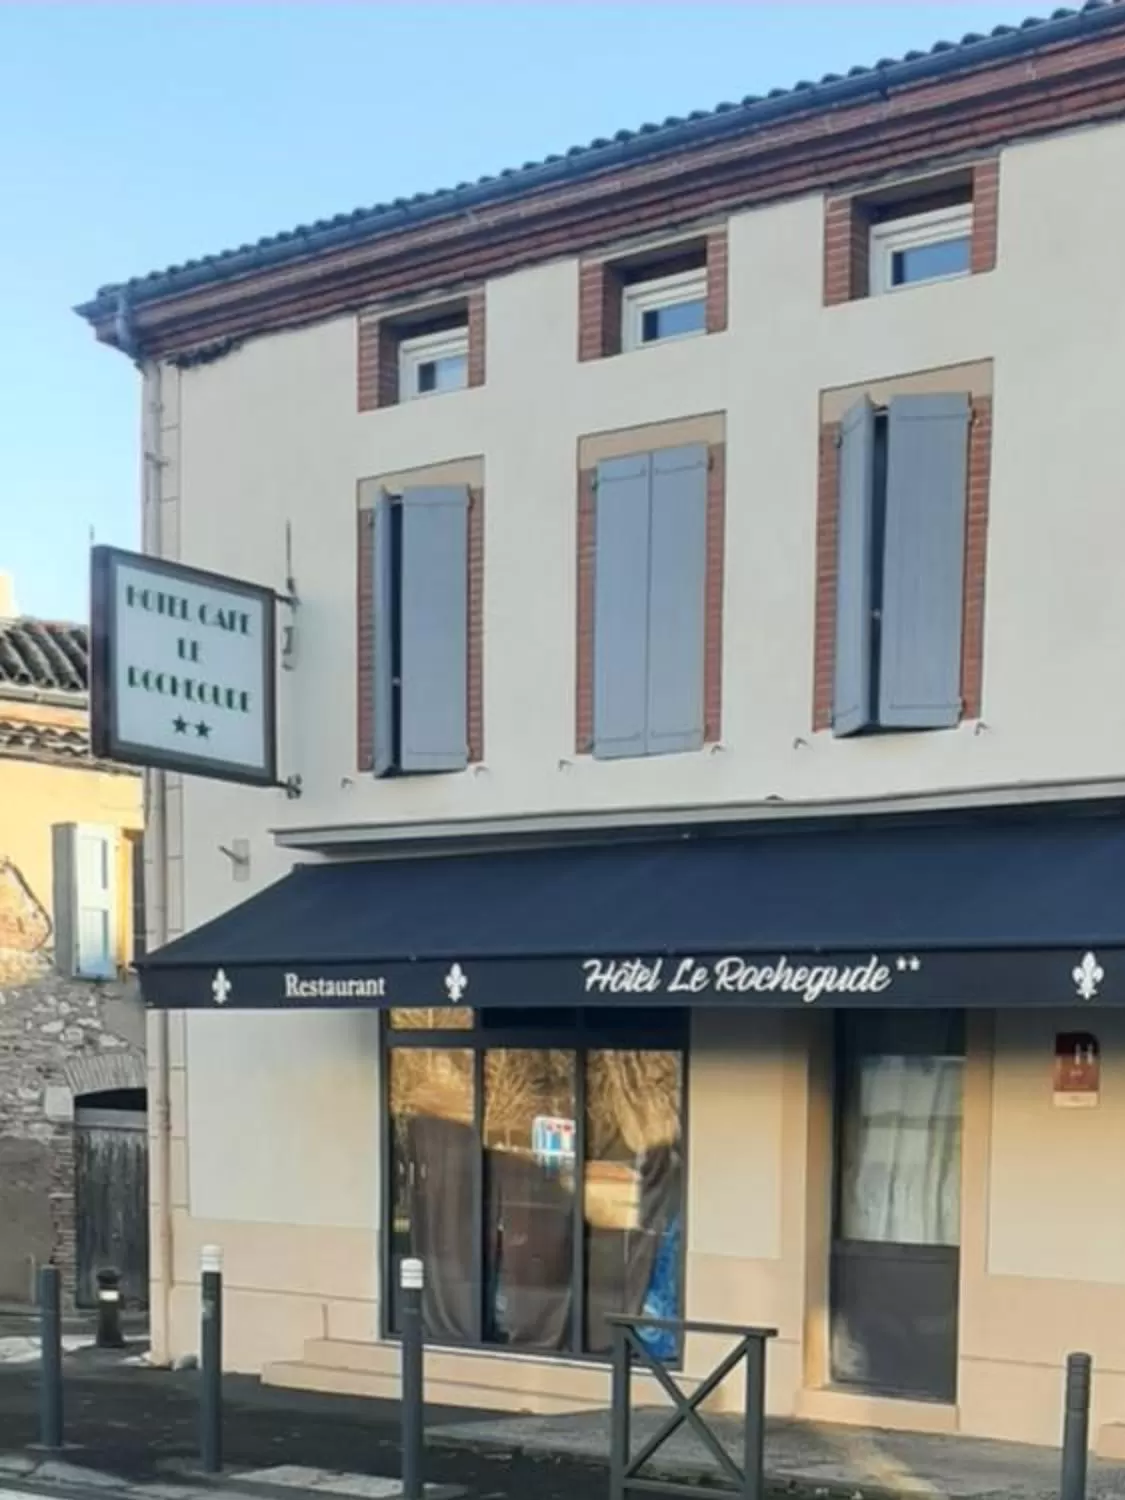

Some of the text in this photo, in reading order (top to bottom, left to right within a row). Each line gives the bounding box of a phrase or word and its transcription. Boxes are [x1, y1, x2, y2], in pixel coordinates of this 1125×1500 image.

[126, 584, 191, 621] HOTEL
[178, 637, 200, 663] LE
[284, 973, 385, 997] Restaurant
[582, 955, 893, 1003] Hôtel Le Rochegude
